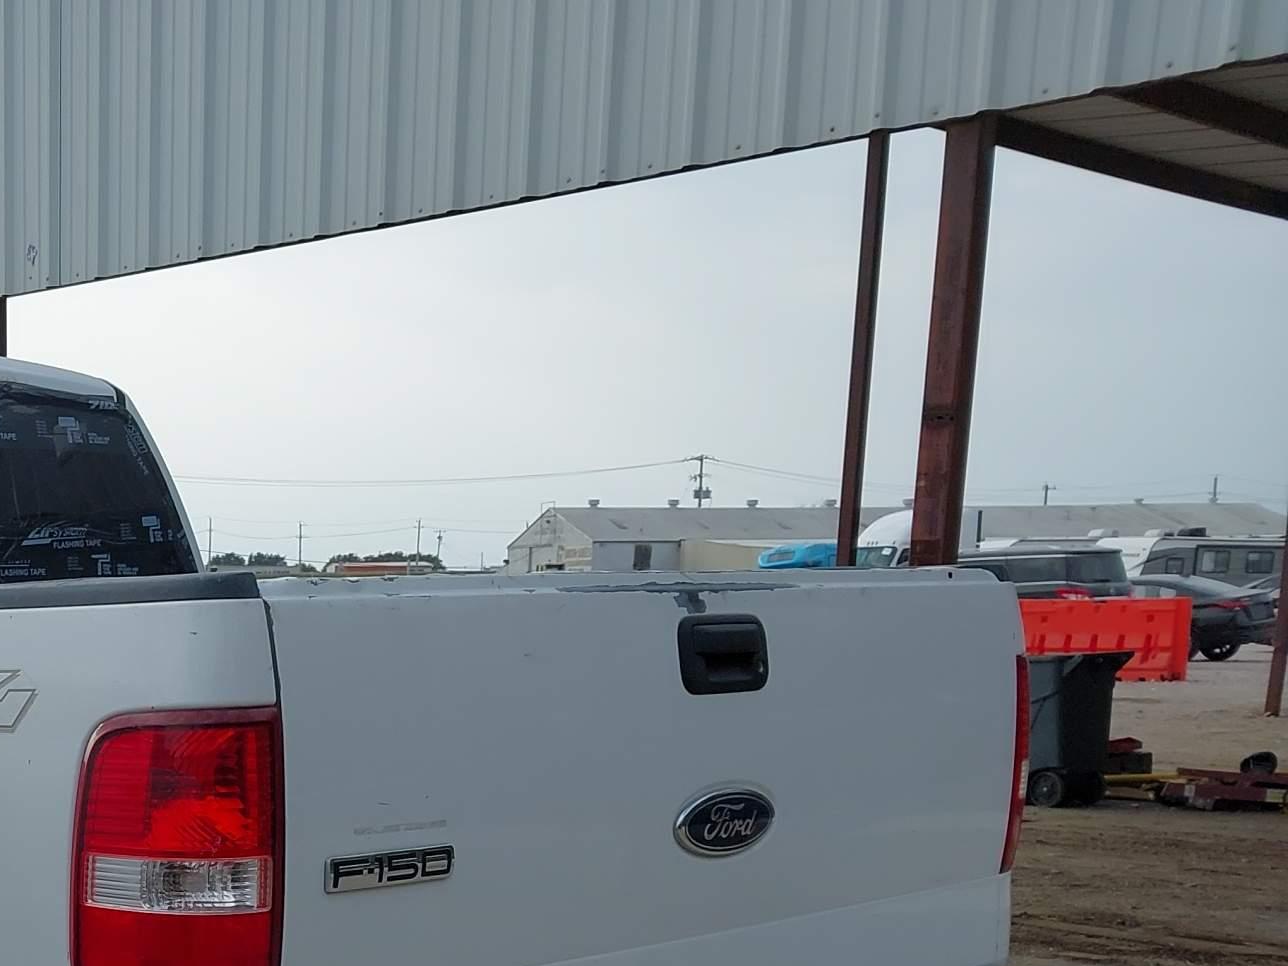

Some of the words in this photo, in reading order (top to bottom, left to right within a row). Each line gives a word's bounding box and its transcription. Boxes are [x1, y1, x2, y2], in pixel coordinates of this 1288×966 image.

[53, 540, 85, 549] FLASHING
[85, 538, 103, 548] TAPE
[30, 567, 47, 576] TAPE
[704, 802, 758, 841] Ford
